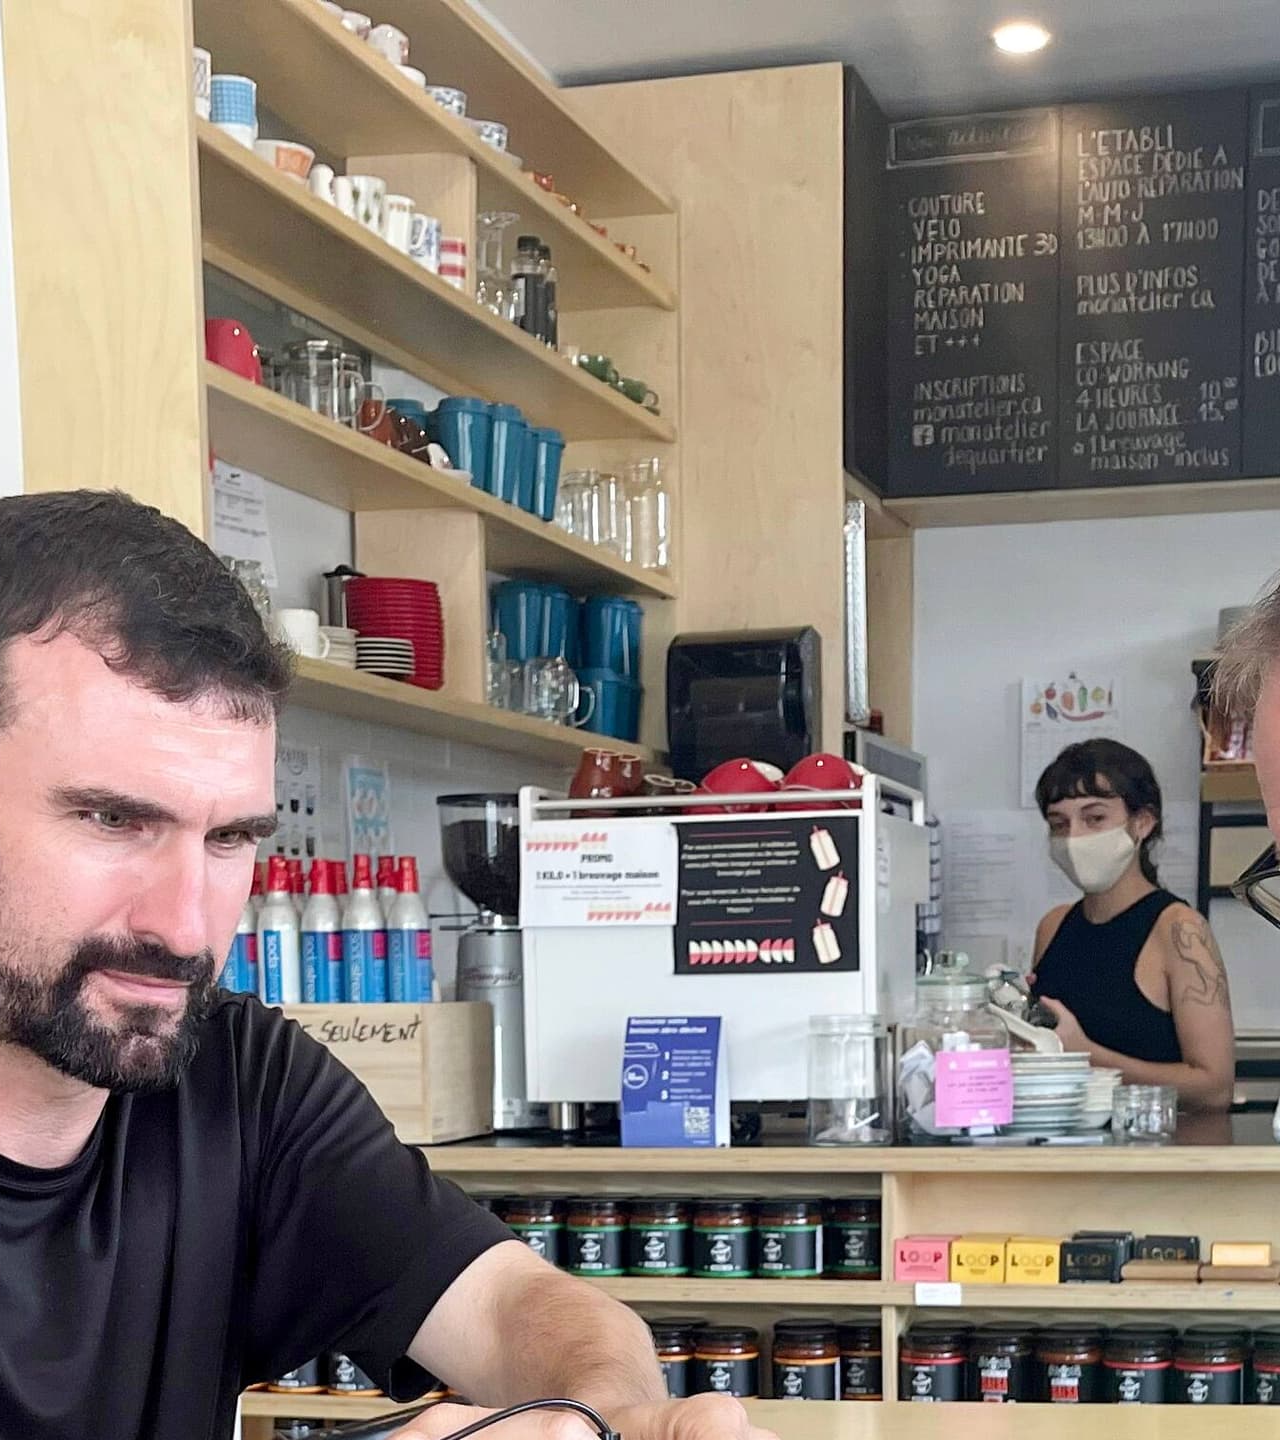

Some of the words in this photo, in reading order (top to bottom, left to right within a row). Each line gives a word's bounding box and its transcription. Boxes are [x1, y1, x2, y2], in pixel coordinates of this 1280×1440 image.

[1079, 153, 1144, 181] ESPACE
[908, 192, 985, 217] COUTURE
[911, 234, 1029, 264] IMPRIMANTE
[912, 264, 961, 286] YOGA
[914, 307, 984, 331] MAISON
[320, 1014, 422, 1044] SEULEMENT
[956, 1253, 999, 1267] LOOP
[1011, 1254, 1054, 1268] LOOP
